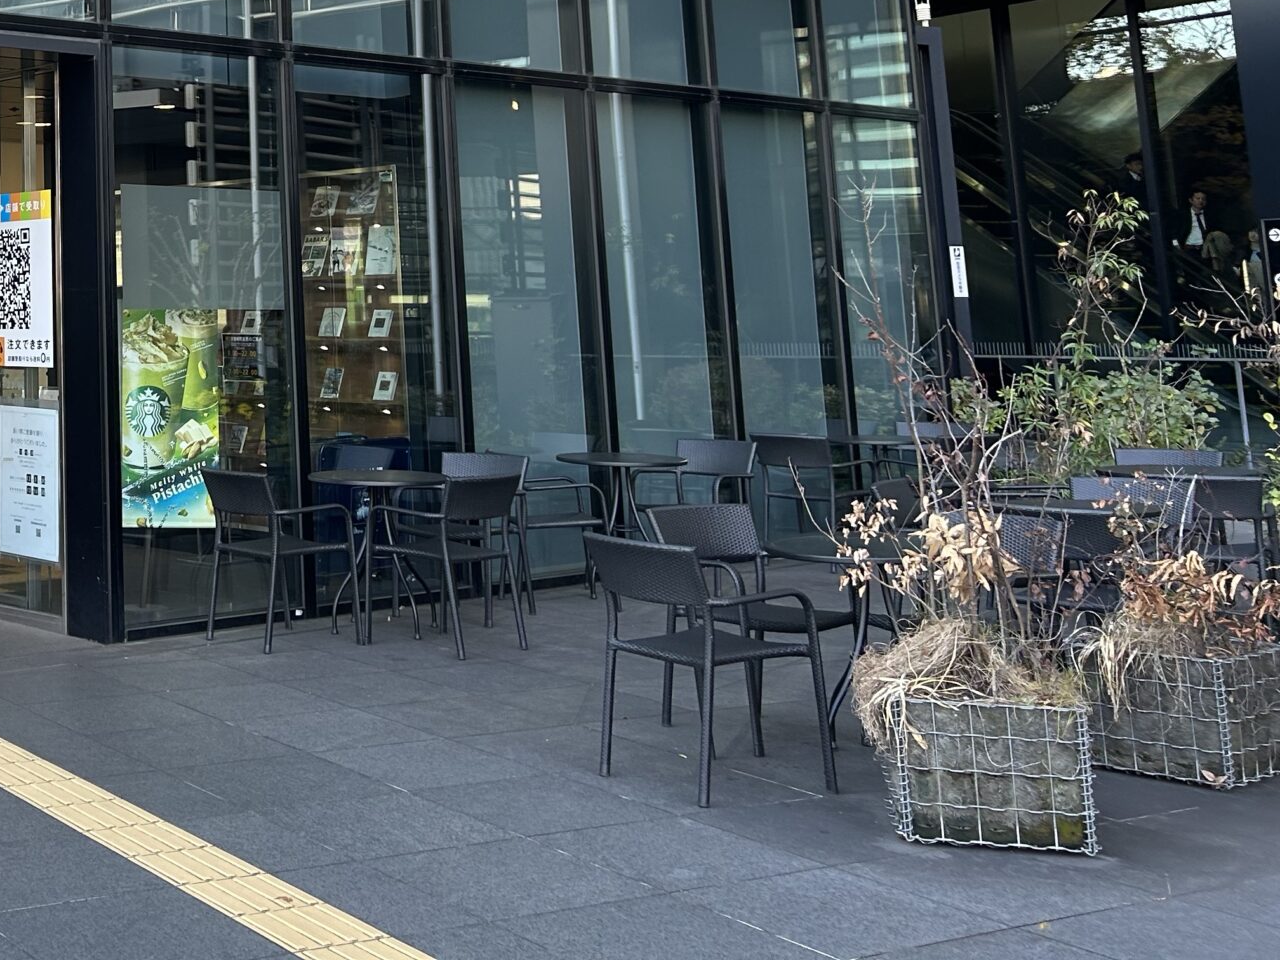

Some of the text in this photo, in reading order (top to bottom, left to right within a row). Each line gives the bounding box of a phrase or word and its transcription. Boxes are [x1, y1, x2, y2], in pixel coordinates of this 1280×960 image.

[7, 339, 51, 351] 注文できます
[150, 474, 176, 491] Melty
[179, 460, 207, 477] White
[152, 470, 205, 505] Pistachi
